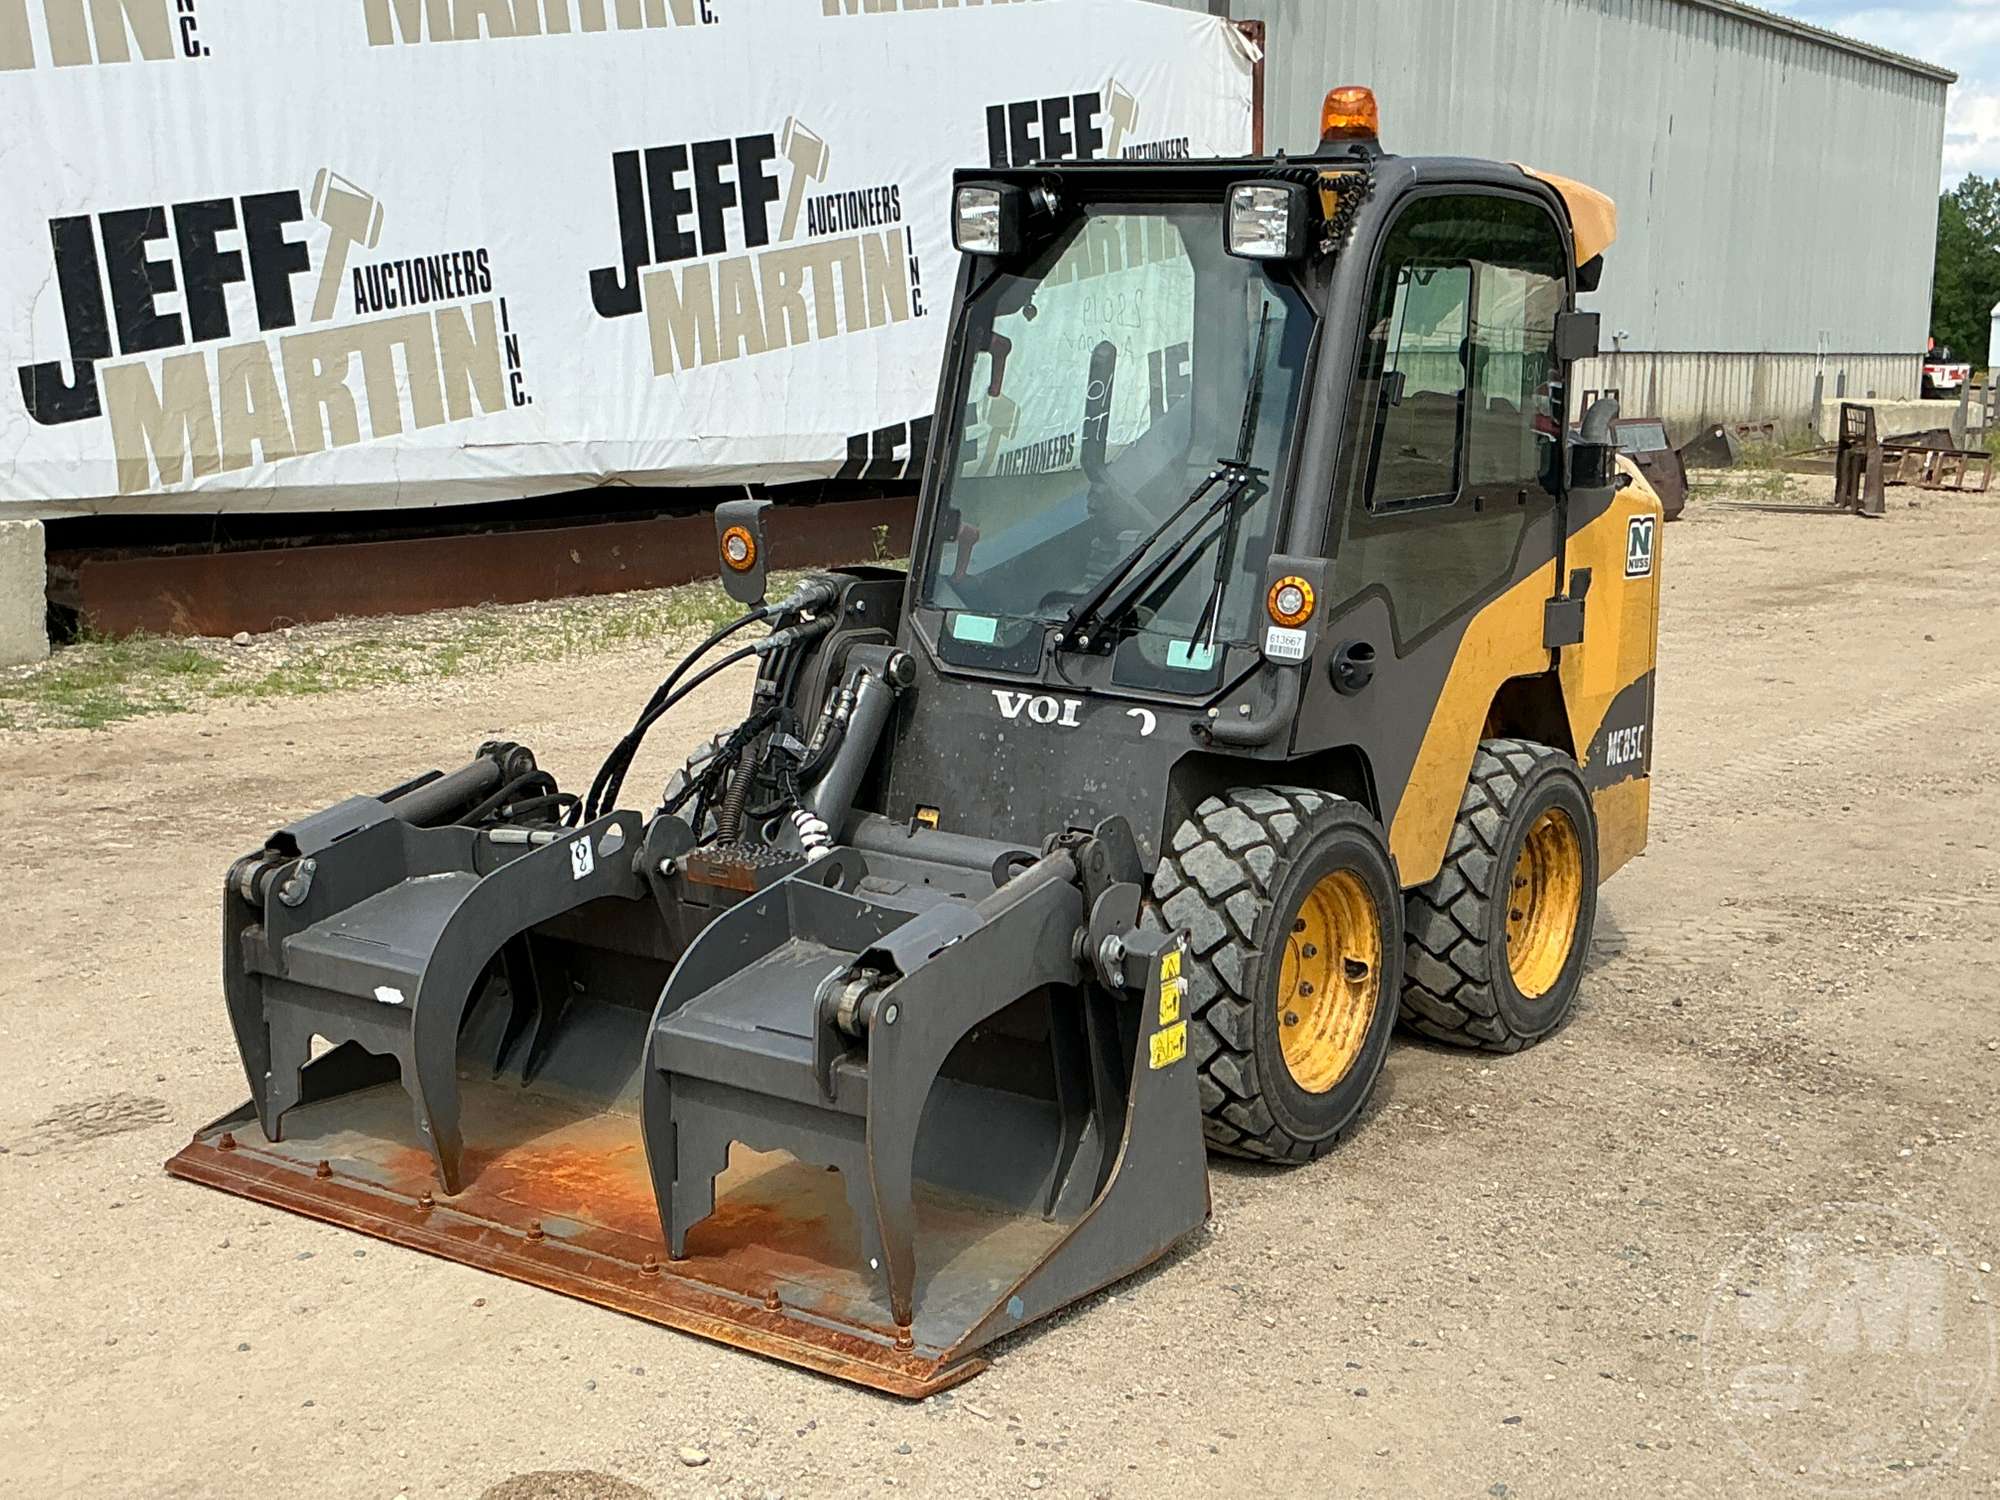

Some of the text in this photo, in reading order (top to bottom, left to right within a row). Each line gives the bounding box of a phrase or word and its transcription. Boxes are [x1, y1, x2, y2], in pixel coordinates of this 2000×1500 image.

[589, 134, 779, 318] JEFF
[807, 184, 900, 238] AUCTIONEERS
[17, 190, 311, 425] JEFF
[352, 248, 492, 315] AUCTIONEERS
[644, 228, 909, 376] MARTIN
[102, 300, 506, 496] MARTIN
[1628, 558, 1649, 569] NUSS
[1606, 725, 1645, 767] MC85C
